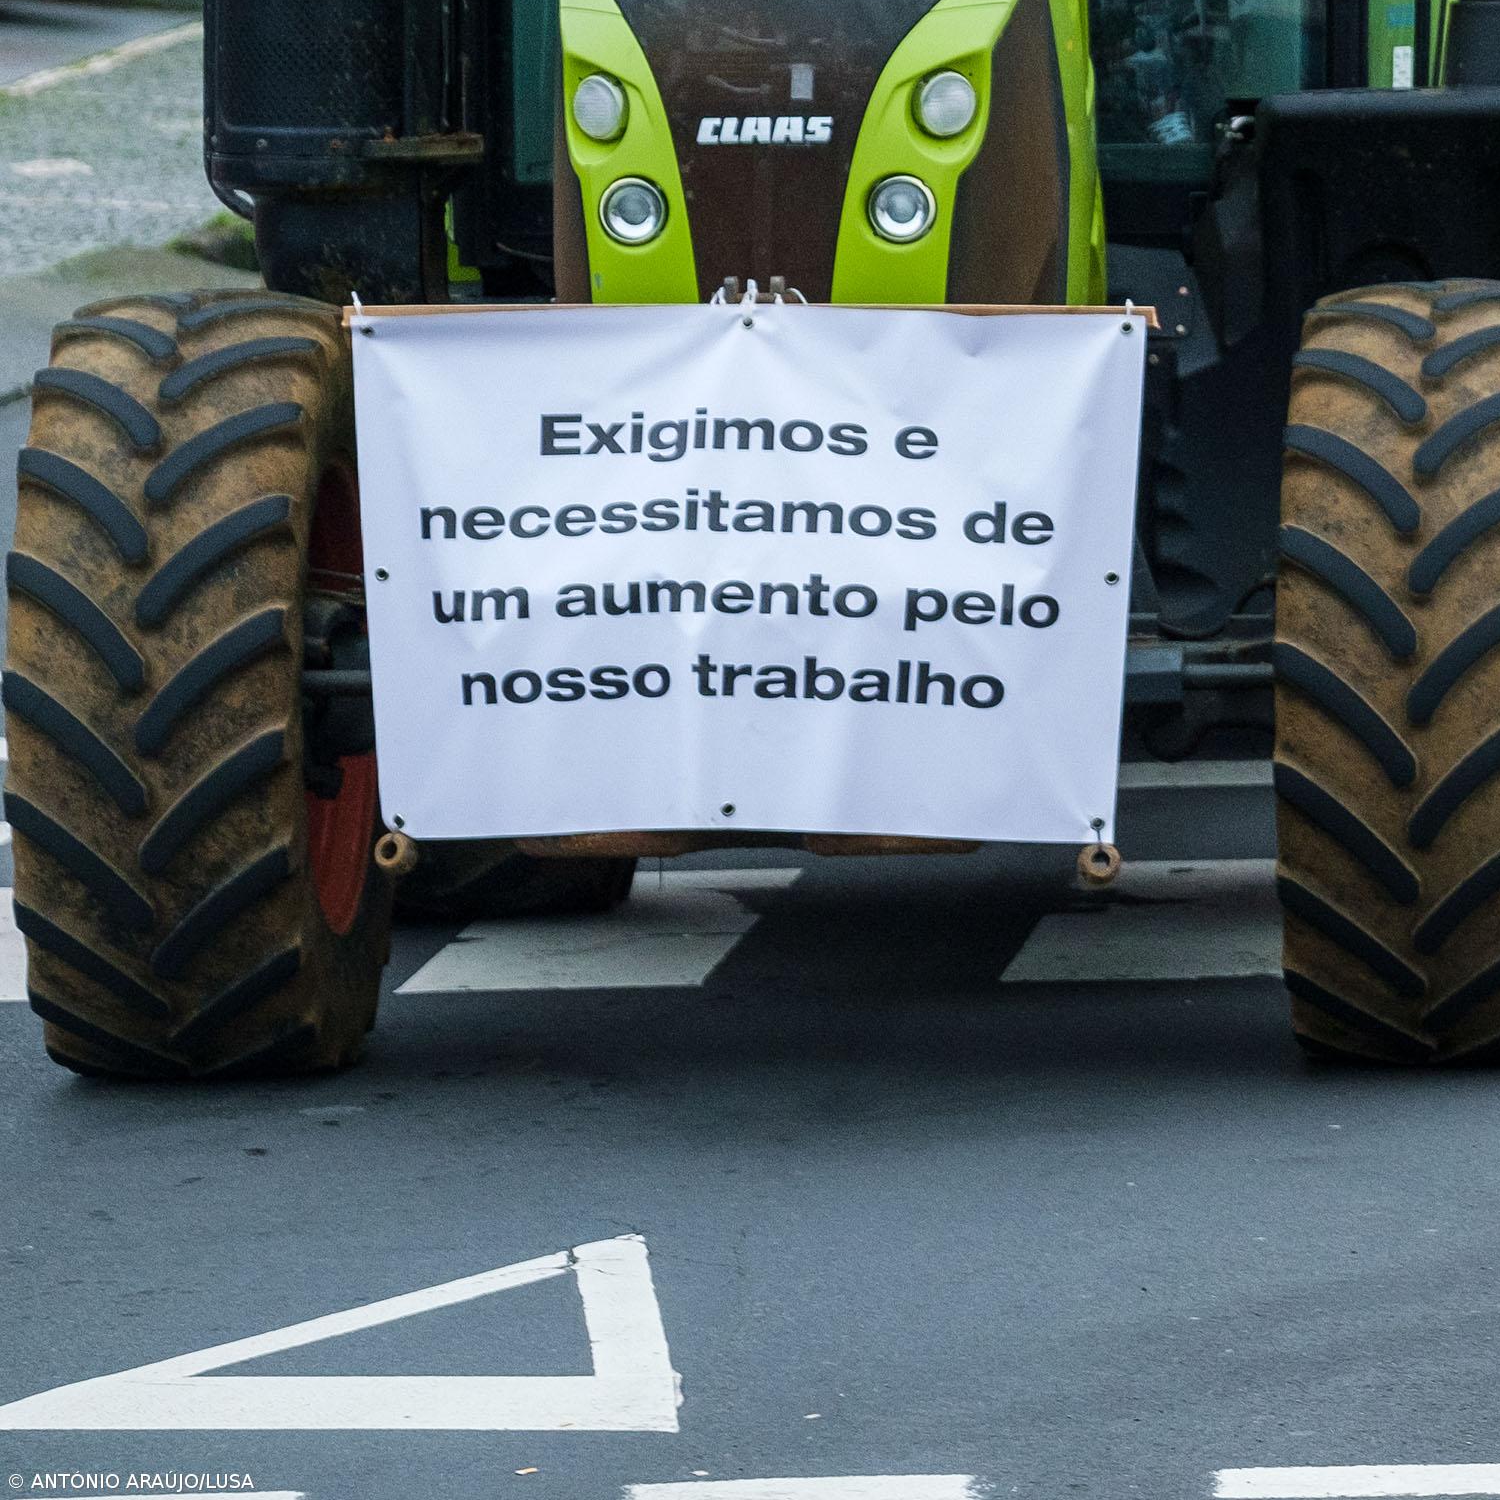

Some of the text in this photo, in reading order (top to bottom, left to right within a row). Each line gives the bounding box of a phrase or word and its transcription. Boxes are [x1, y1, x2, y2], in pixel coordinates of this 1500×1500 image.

[696, 116, 834, 145] CLAAS
[541, 408, 938, 462] Exigimos e
[420, 490, 1054, 546] necessitamos de
[433, 575, 1060, 632] um aumento pelo
[461, 654, 1005, 709] nosso trabalho
